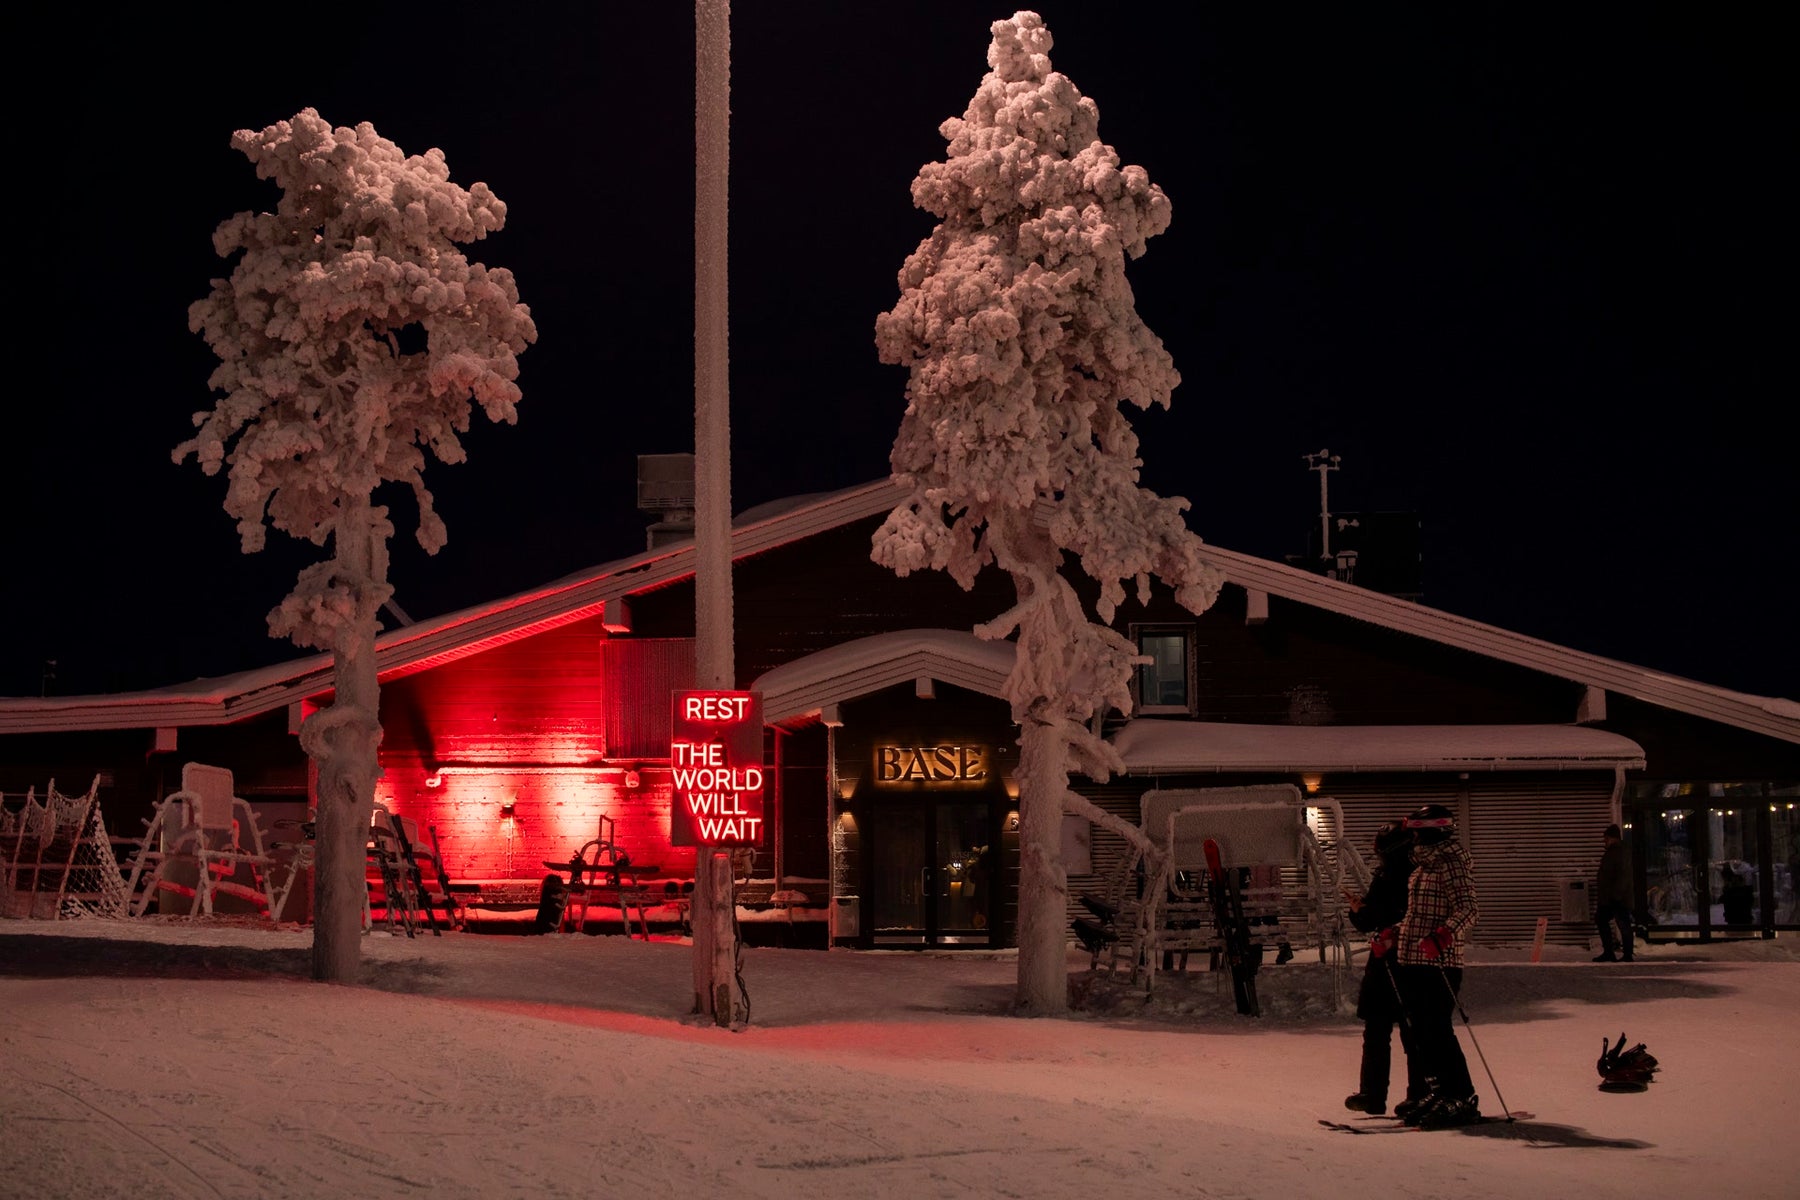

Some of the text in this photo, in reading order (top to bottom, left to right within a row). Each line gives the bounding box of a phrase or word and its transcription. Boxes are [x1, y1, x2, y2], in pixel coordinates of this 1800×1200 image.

[686, 697, 749, 720] REST
[672, 743, 723, 766] THE
[878, 746, 987, 780] BASE
[672, 768, 763, 791] WORLD
[688, 793, 748, 815] WILL
[699, 818, 761, 840] WAIT
